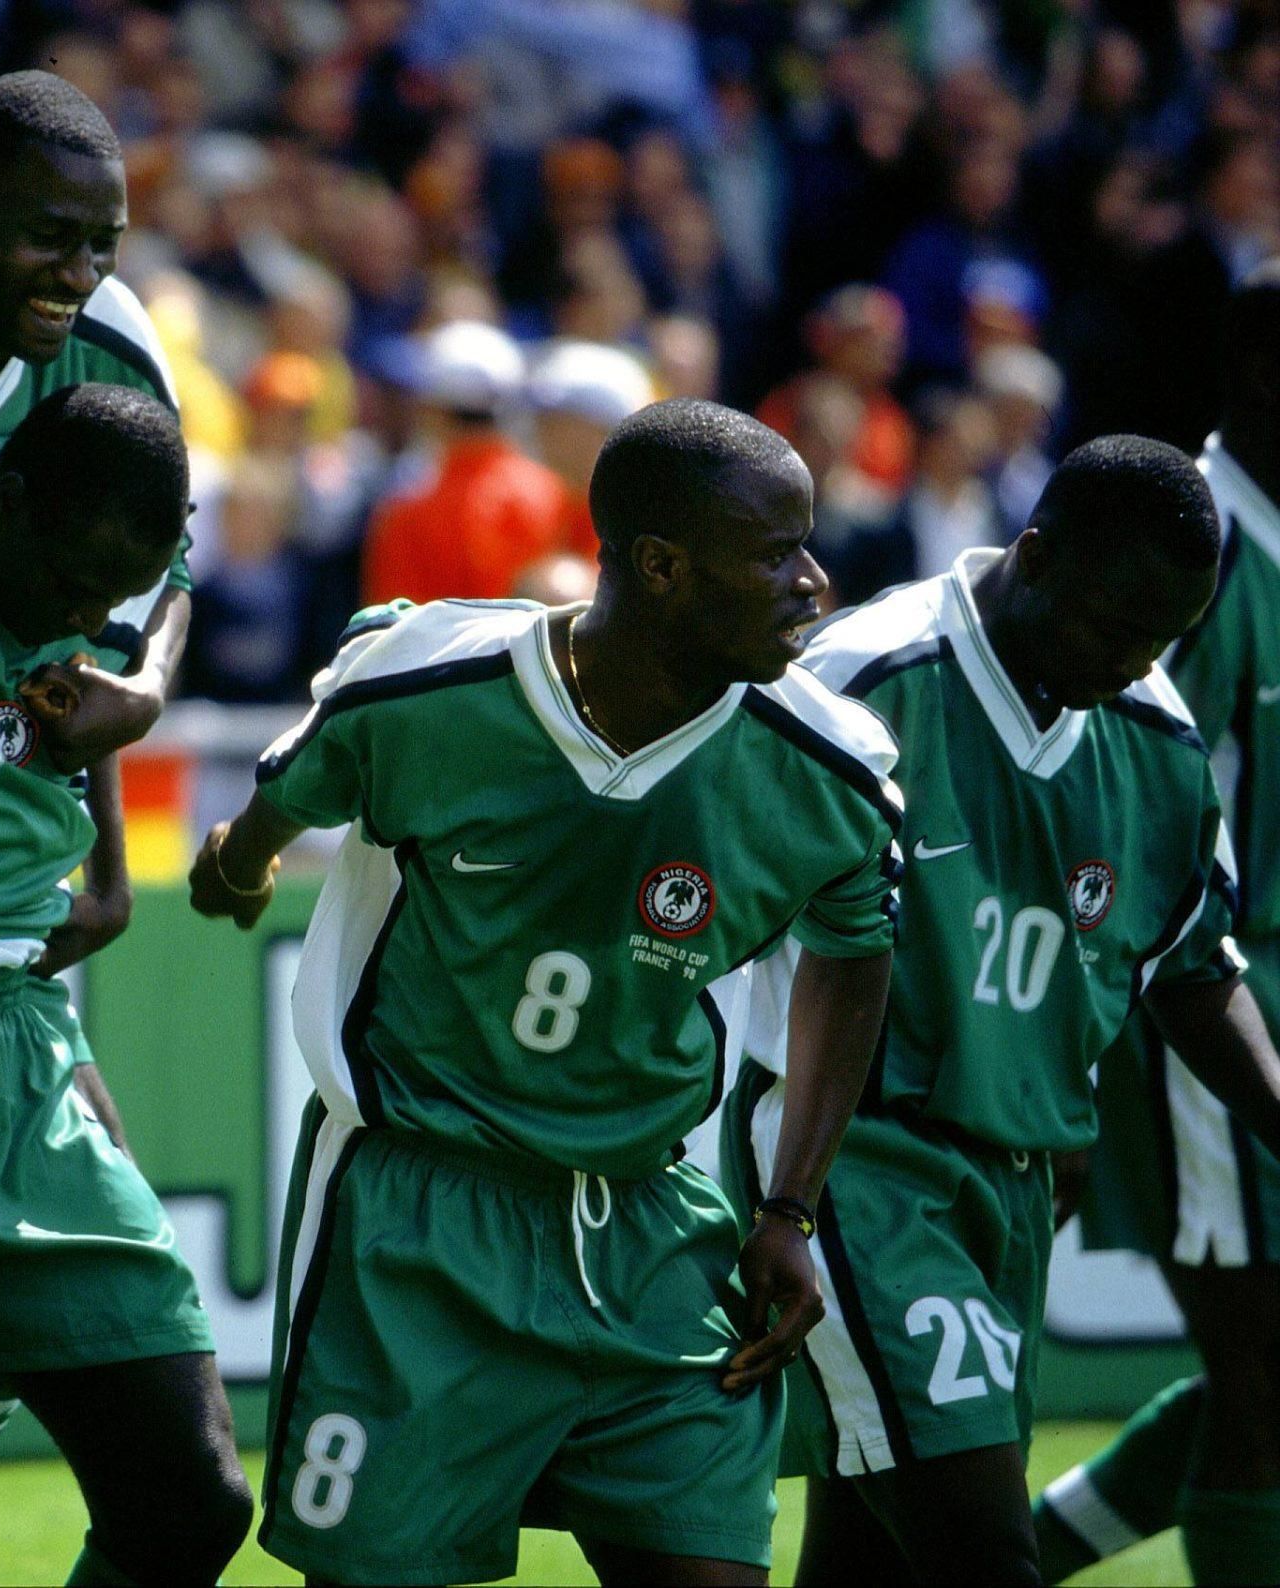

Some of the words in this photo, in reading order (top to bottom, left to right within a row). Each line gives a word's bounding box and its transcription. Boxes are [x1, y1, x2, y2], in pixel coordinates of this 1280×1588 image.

[661, 867, 709, 896] NIGERIA
[512, 950, 592, 1053] 8
[629, 934, 650, 949] FIFA
[652, 939, 687, 961] WORLD
[688, 951, 710, 967] CUP
[632, 949, 672, 971] FRANCE
[682, 966, 698, 980] 98
[973, 896, 1065, 1012] 20
[905, 1296, 1022, 1406] 20
[291, 1413, 368, 1529] 8
